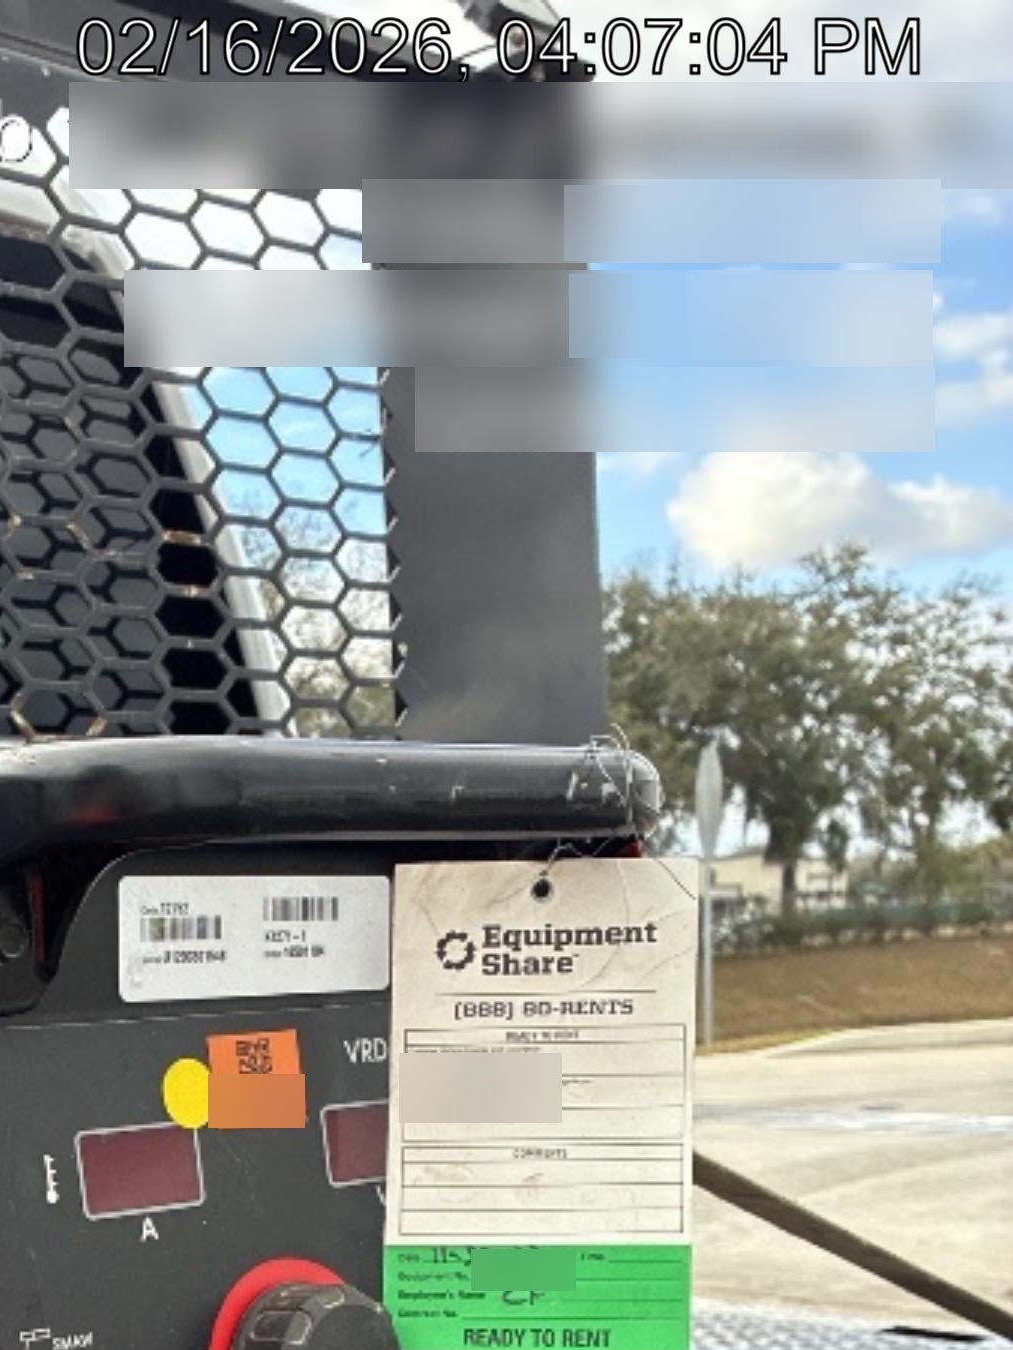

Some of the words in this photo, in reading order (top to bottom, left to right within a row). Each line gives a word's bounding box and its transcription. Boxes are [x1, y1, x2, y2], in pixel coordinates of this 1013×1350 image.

[481, 922, 658, 951] Equipment
[481, 953, 574, 976] Share
[343, 1037, 388, 1064] VRD
[140, 1218, 159, 1241] A
[463, 1328, 525, 1349] READY
[530, 1328, 556, 1348] TO
[562, 1328, 612, 1348] RENT
